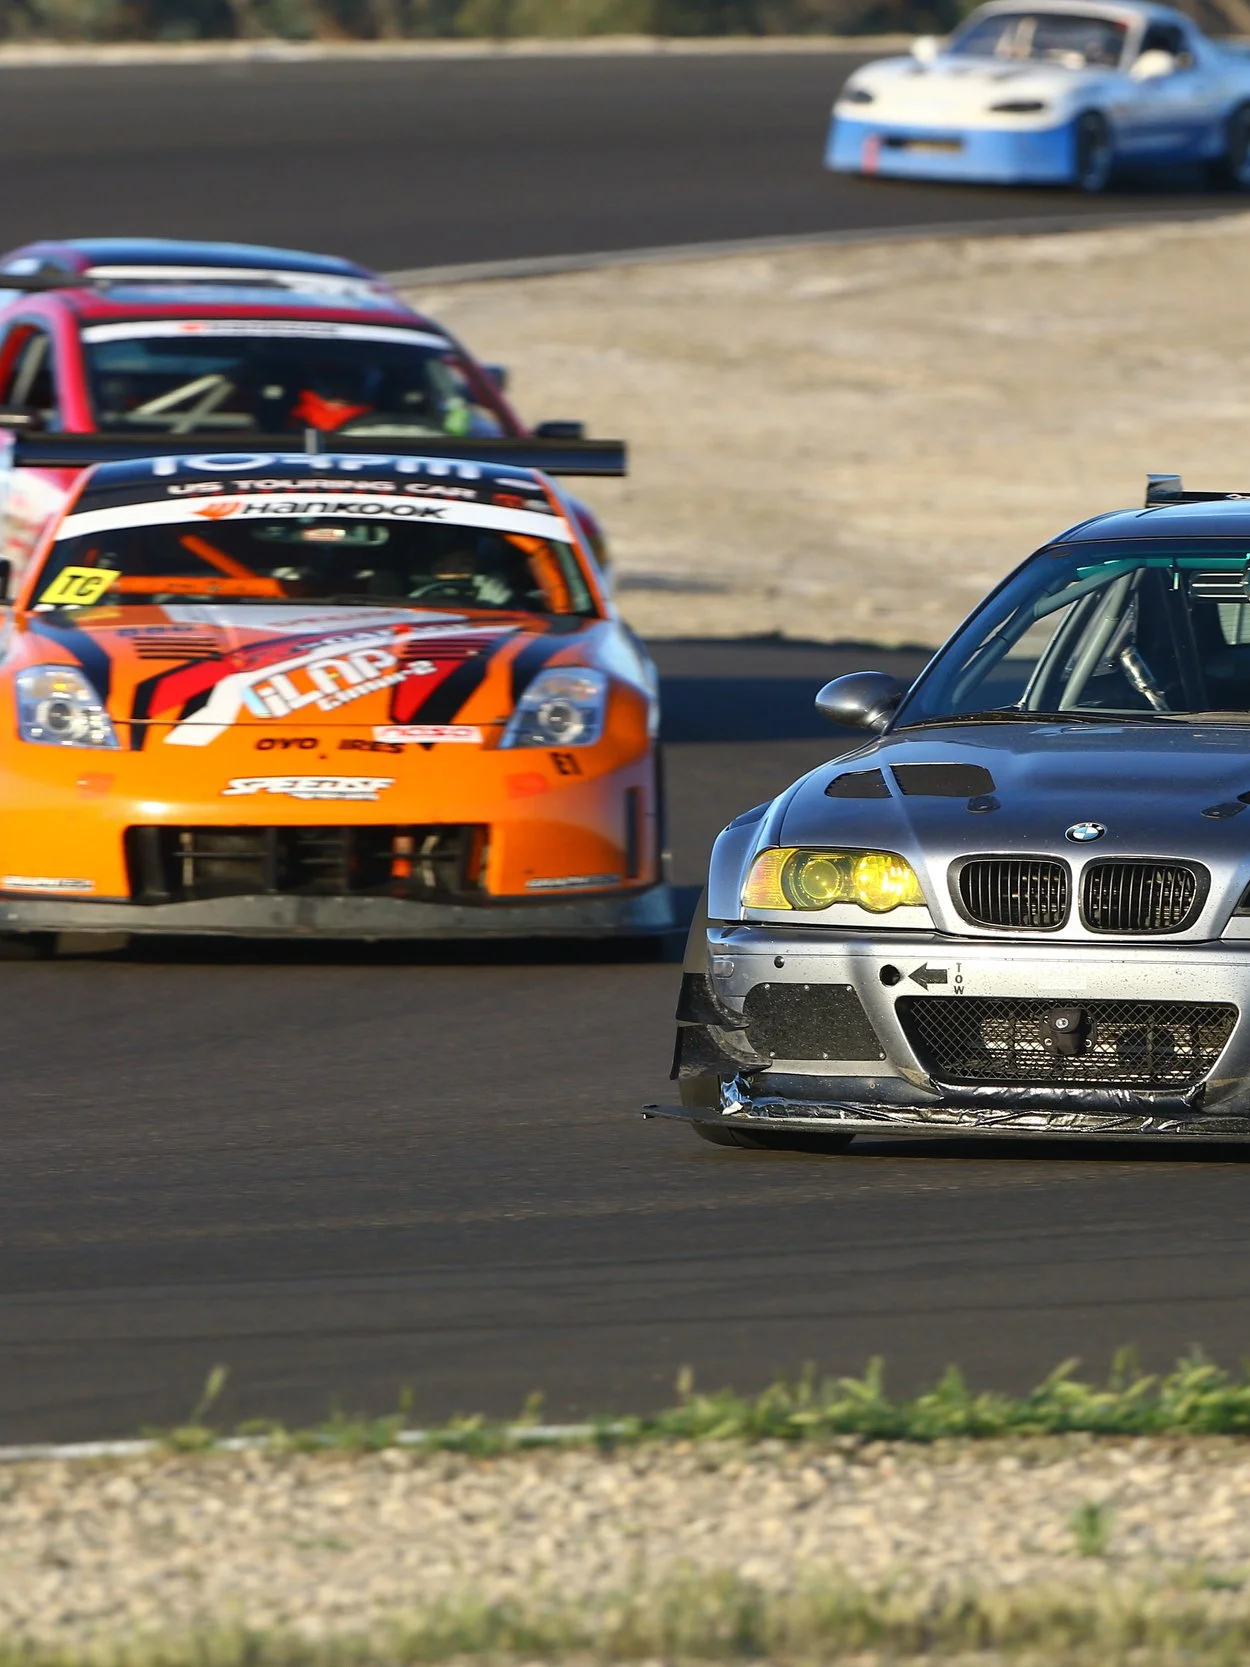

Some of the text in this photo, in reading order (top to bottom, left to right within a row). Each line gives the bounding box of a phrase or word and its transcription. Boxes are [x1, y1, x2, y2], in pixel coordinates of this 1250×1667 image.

[166, 478, 478, 499] US TOURING CAR
[953, 962, 965, 995] TOW
